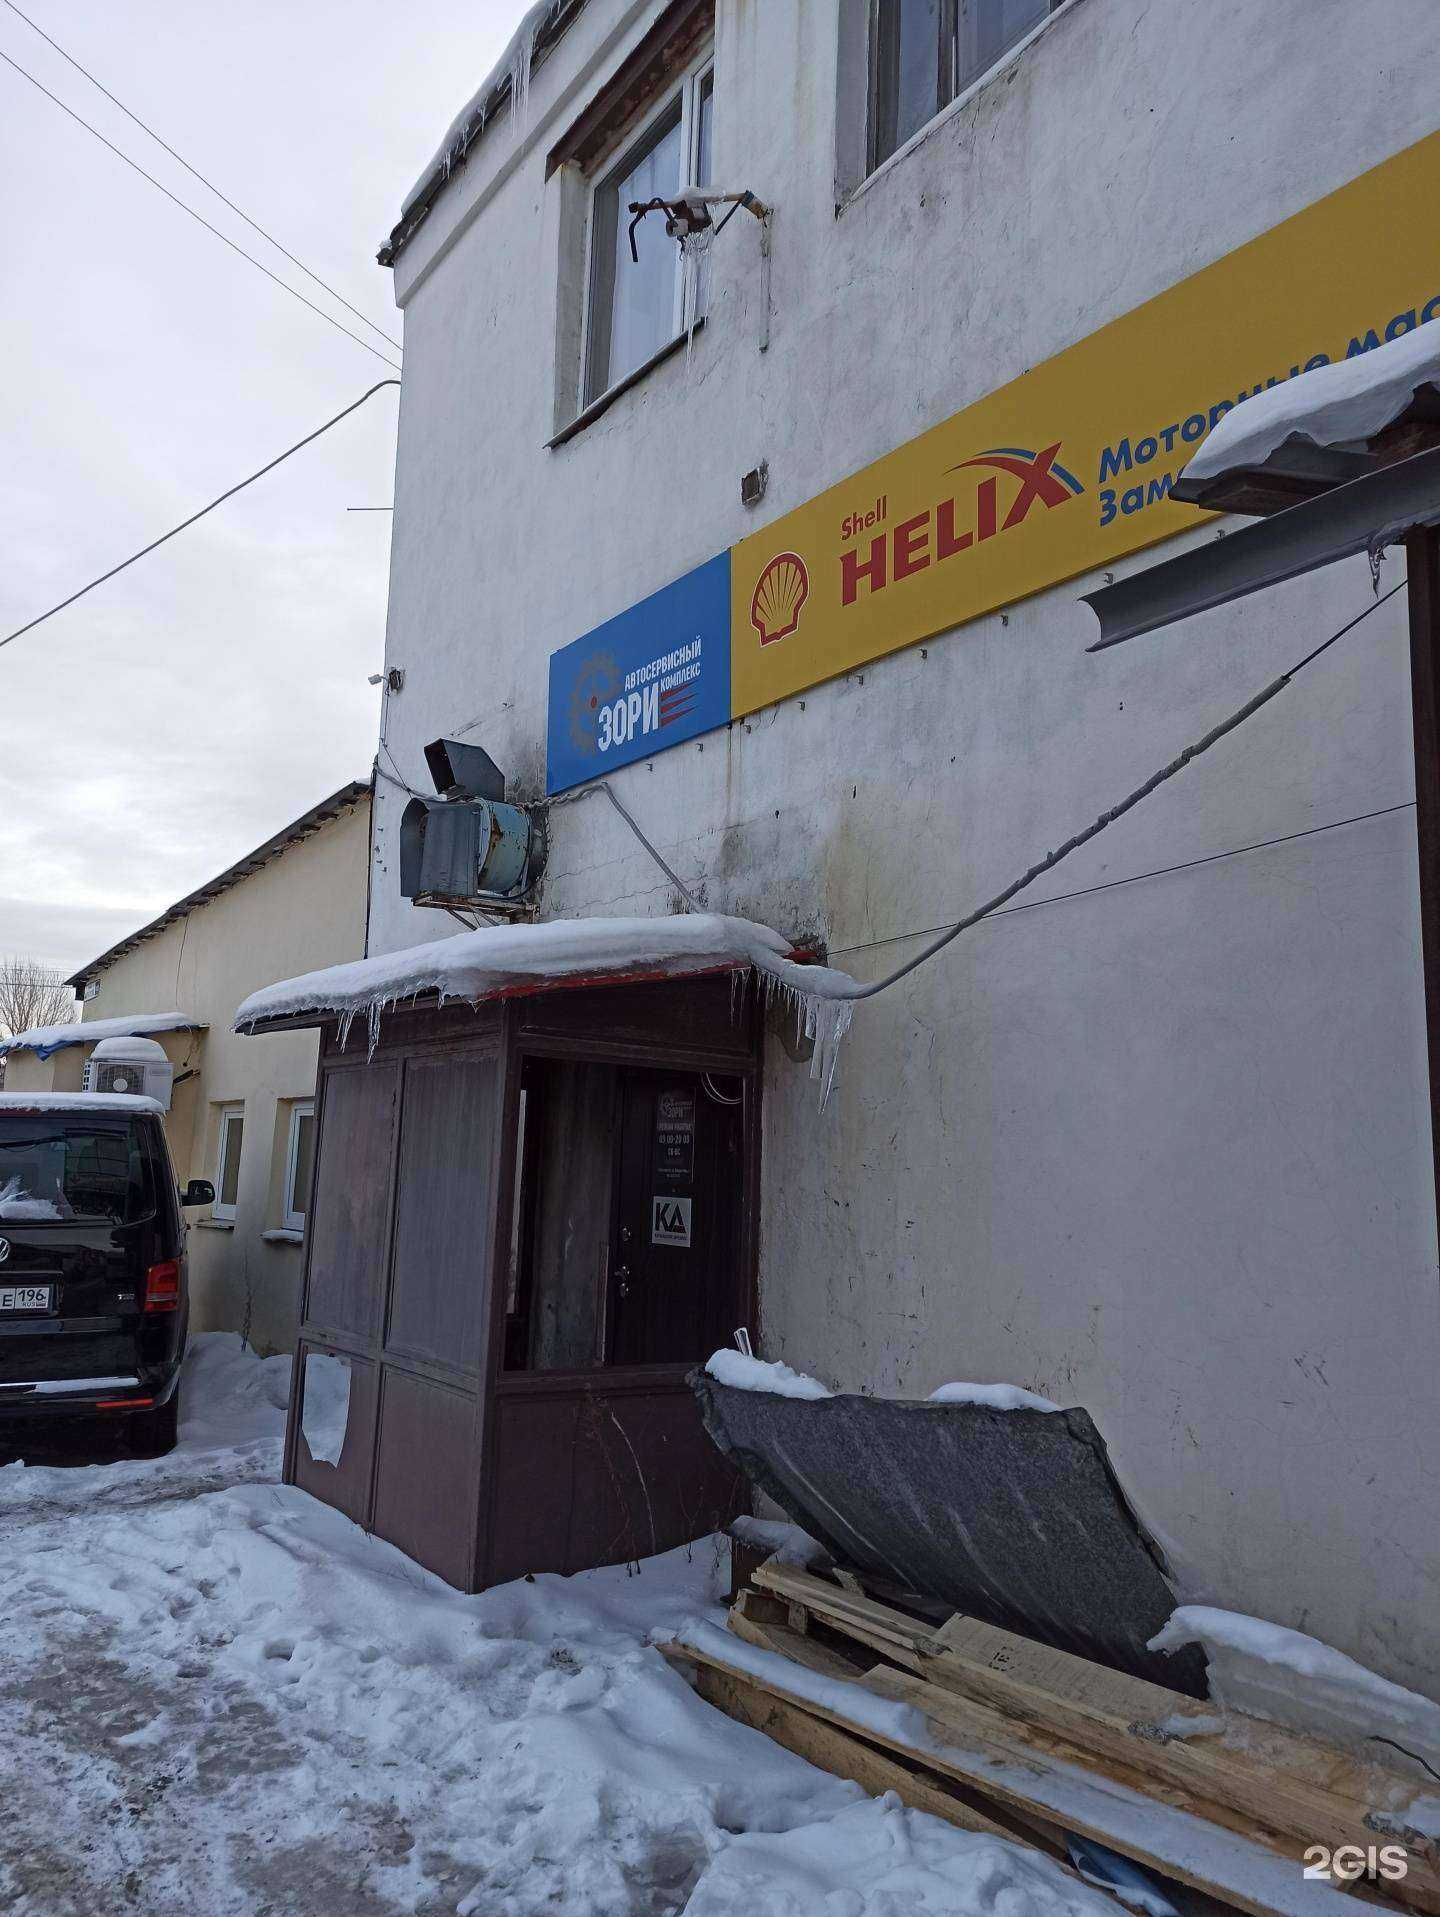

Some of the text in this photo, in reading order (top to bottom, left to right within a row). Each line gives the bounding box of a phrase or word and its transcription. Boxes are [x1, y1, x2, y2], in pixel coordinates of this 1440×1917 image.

[839, 441, 1073, 607] HELIX
[841, 495, 887, 541] Shell
[1099, 465, 1187, 527] Зам
[624, 634, 702, 692] АВТОСЕРВИСНЫЙ
[660, 661, 701, 692] КОМПЛЕКС
[598, 681, 660, 752] ЗОРИ
[18, 1289, 46, 1302] 196
